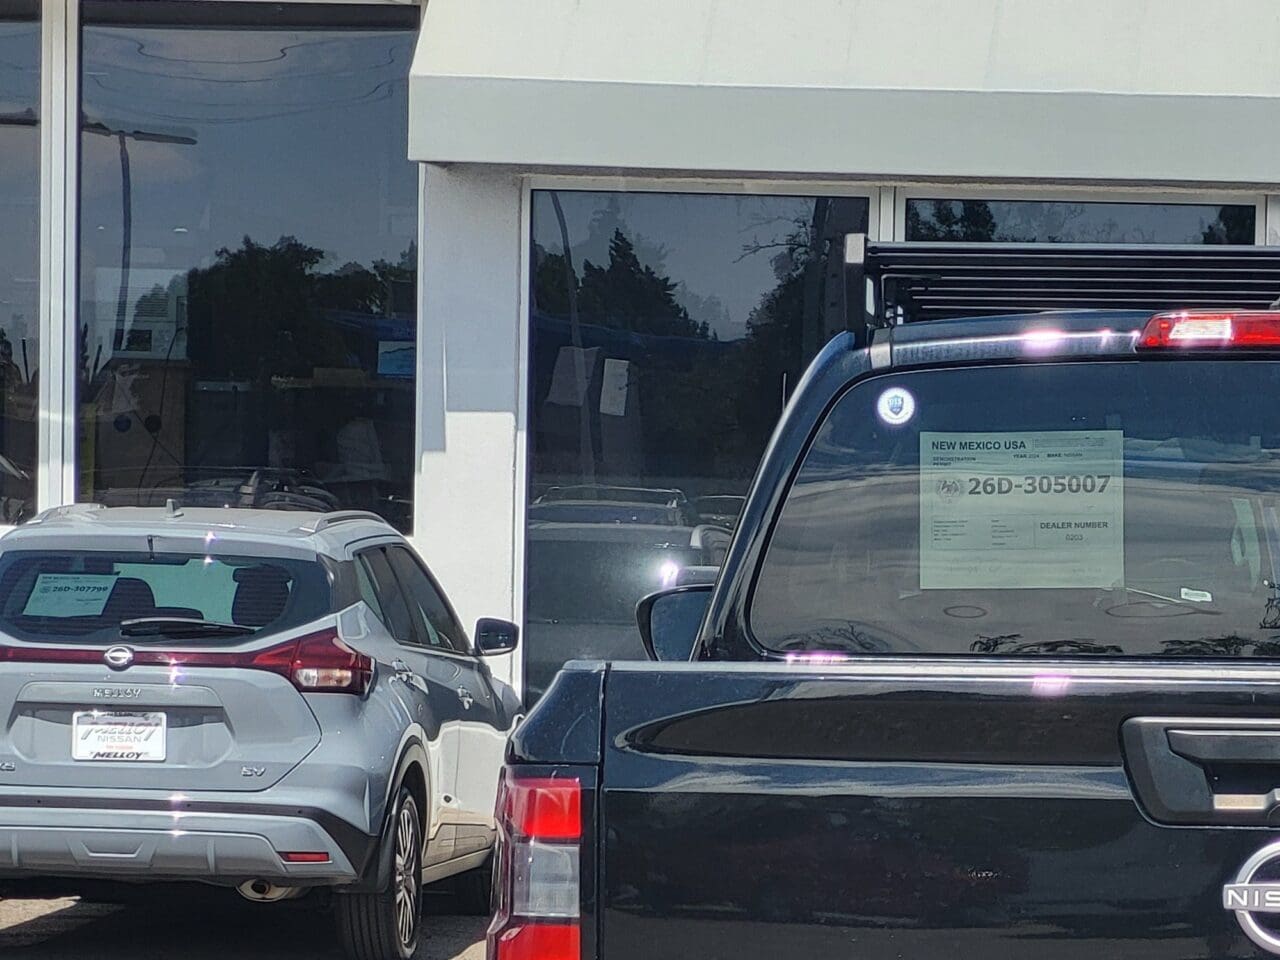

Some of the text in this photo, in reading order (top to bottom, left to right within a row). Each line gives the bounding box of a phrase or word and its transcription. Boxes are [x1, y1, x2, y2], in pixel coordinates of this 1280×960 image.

[931, 441, 956, 450] NEW
[959, 440, 1001, 450] MEXICO
[1004, 440, 1026, 450] USA
[967, 475, 1111, 496] 26D-305007
[1074, 521, 1109, 529] NUMBER
